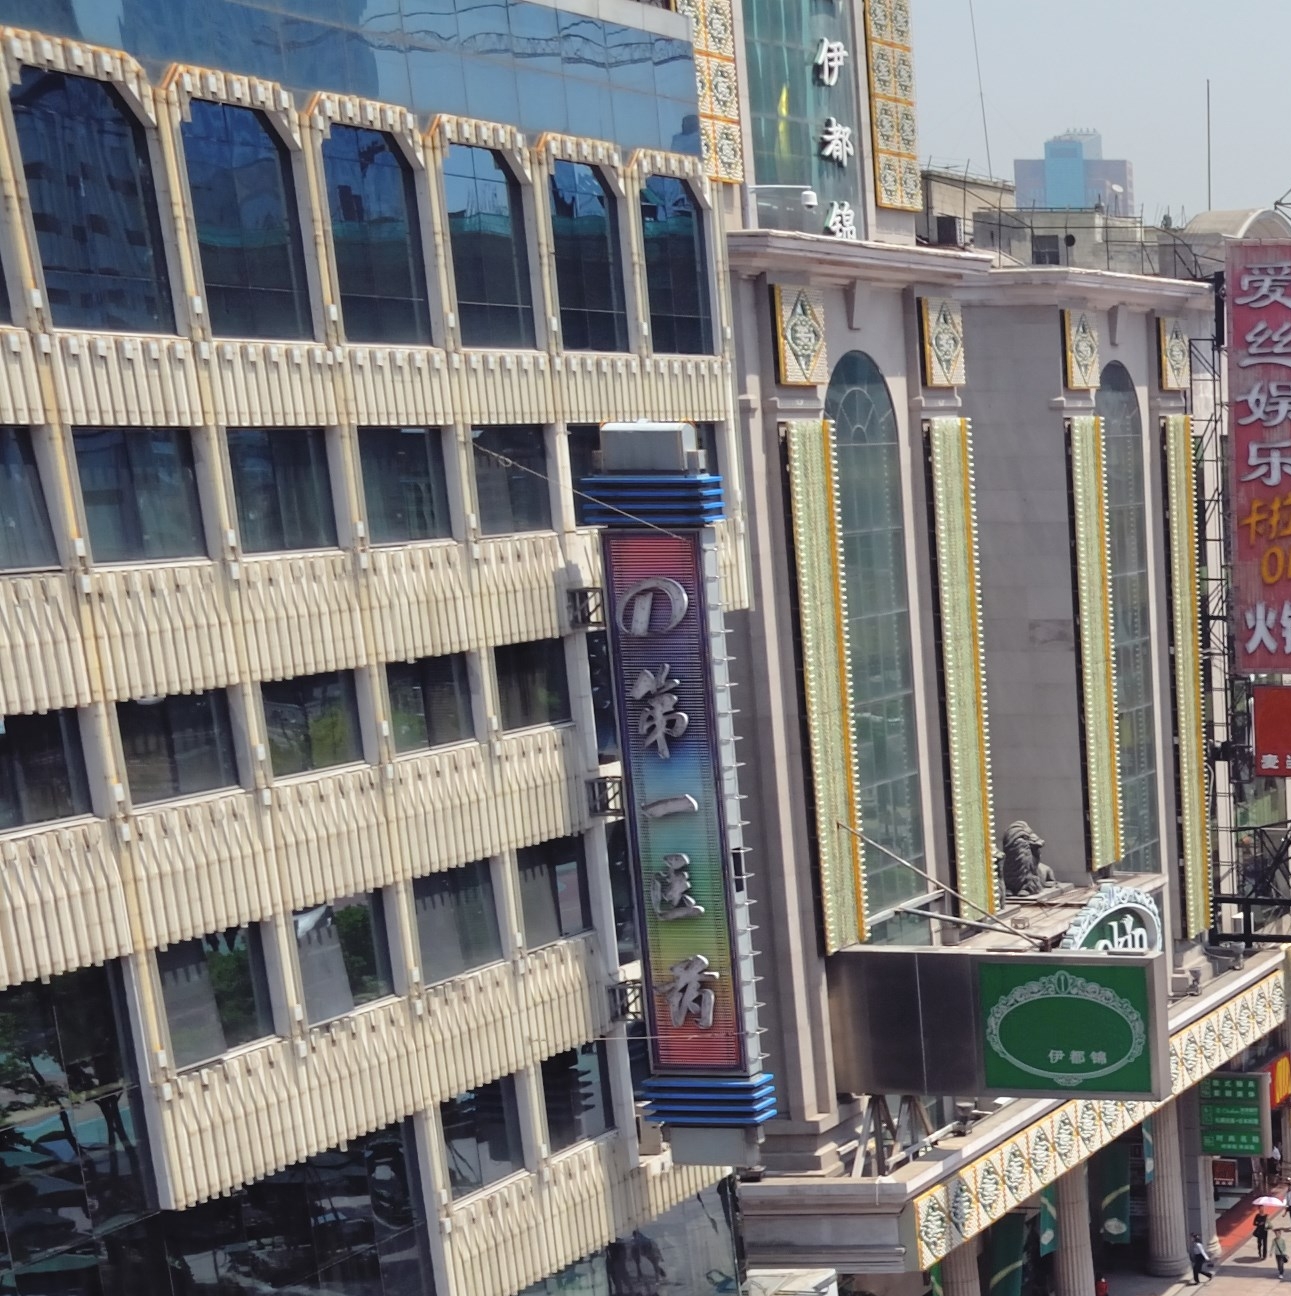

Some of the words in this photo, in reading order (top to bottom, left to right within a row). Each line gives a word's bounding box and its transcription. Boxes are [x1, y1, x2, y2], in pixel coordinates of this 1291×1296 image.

[814, 36, 857, 240] 伊都锦
[1048, 1049, 1107, 1065] 伊都锦
